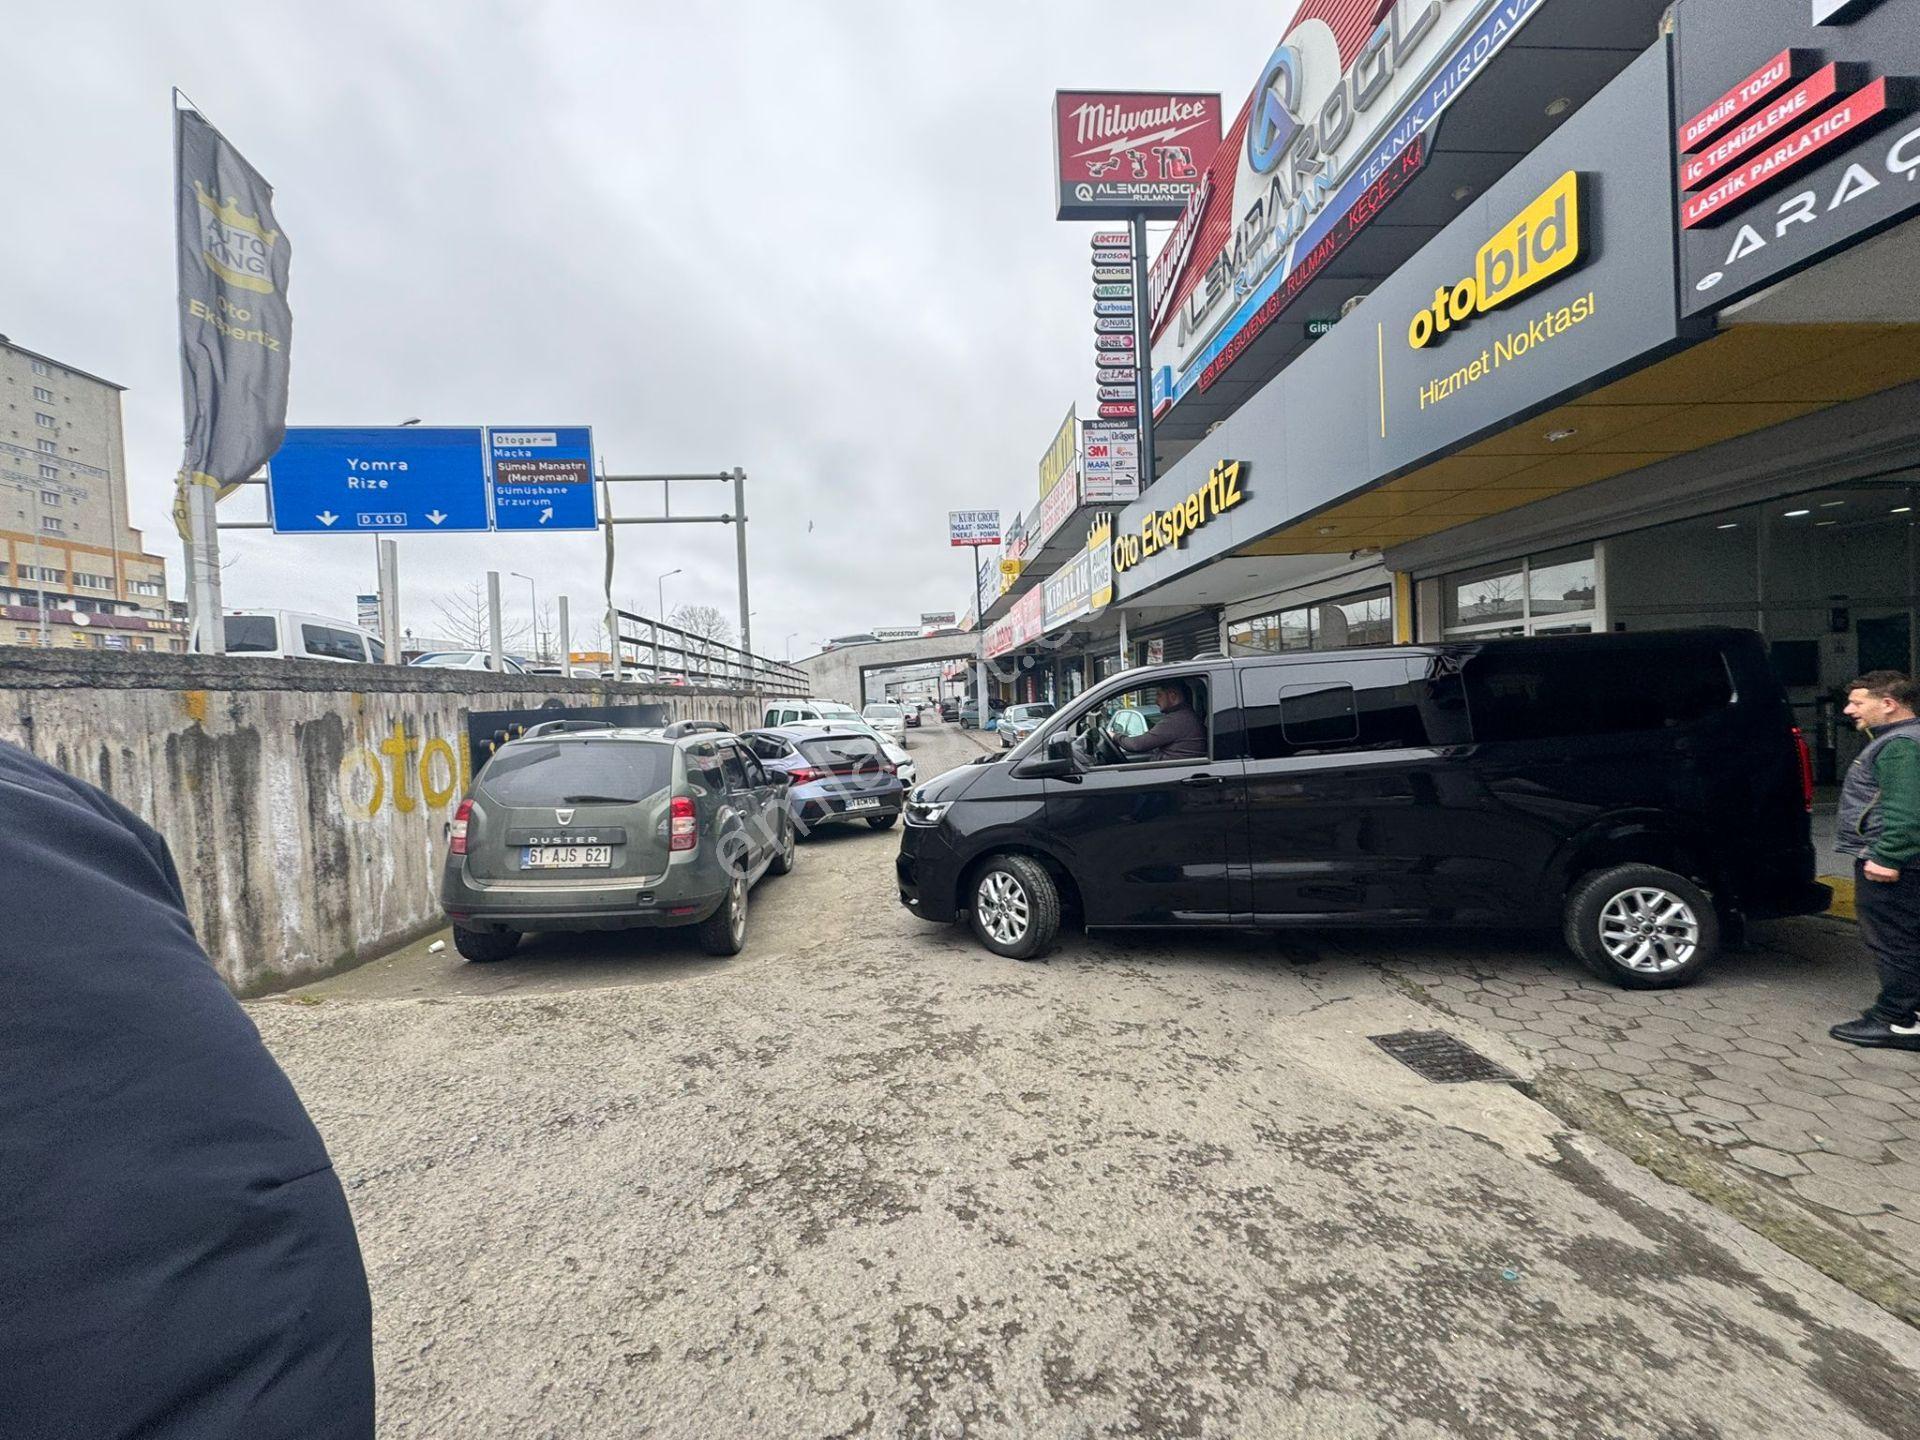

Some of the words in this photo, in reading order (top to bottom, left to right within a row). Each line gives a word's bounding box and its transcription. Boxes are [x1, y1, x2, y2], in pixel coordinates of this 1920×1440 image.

[1687, 98, 1736, 141] DEMİR
[1740, 62, 1784, 102] TOZU
[1068, 97, 1206, 144] Milwaukee
[1707, 89, 1807, 166] TEMİZLEME
[1360, 106, 1425, 187] TEKNİK
[1177, 0, 1450, 347] ALEMDAROĞL
[1689, 173, 1747, 219] LASTİK
[1751, 108, 1851, 181] PARLATICI
[207, 218, 265, 257] AUTO
[1094, 235, 1129, 243] LOCTITE
[1287, 232, 1336, 291] RULMAN
[1349, 172, 1391, 228] KEÇE
[1408, 190, 1569, 349] otobid
[217, 296, 250, 321] Oto
[1097, 302, 1132, 311] Karbosan
[189, 299, 280, 351] Ekspertiz
[1309, 320, 1336, 333] GİRİ
[1420, 350, 1489, 410] Hizmet
[1494, 292, 1595, 368] Noktası
[496, 436, 537, 445] Otogar
[1088, 446, 1107, 456] 3M
[346, 458, 409, 472] Yomra
[498, 462, 536, 471] Sümela
[1087, 461, 1109, 469] MAPA
[347, 476, 389, 490] Rize
[507, 472, 578, 483] (Meryemana)
[497, 497, 552, 506] Erzurum
[958, 513, 976, 522] KURT
[1114, 534, 1139, 572] Oto
[1142, 459, 1241, 557] Ekspertiz
[1046, 561, 1089, 613] KİRALIK
[529, 836, 598, 844] DUSTER
[530, 849, 543, 863] 61
[552, 848, 577, 862] AJS
[585, 848, 608, 862] 621
